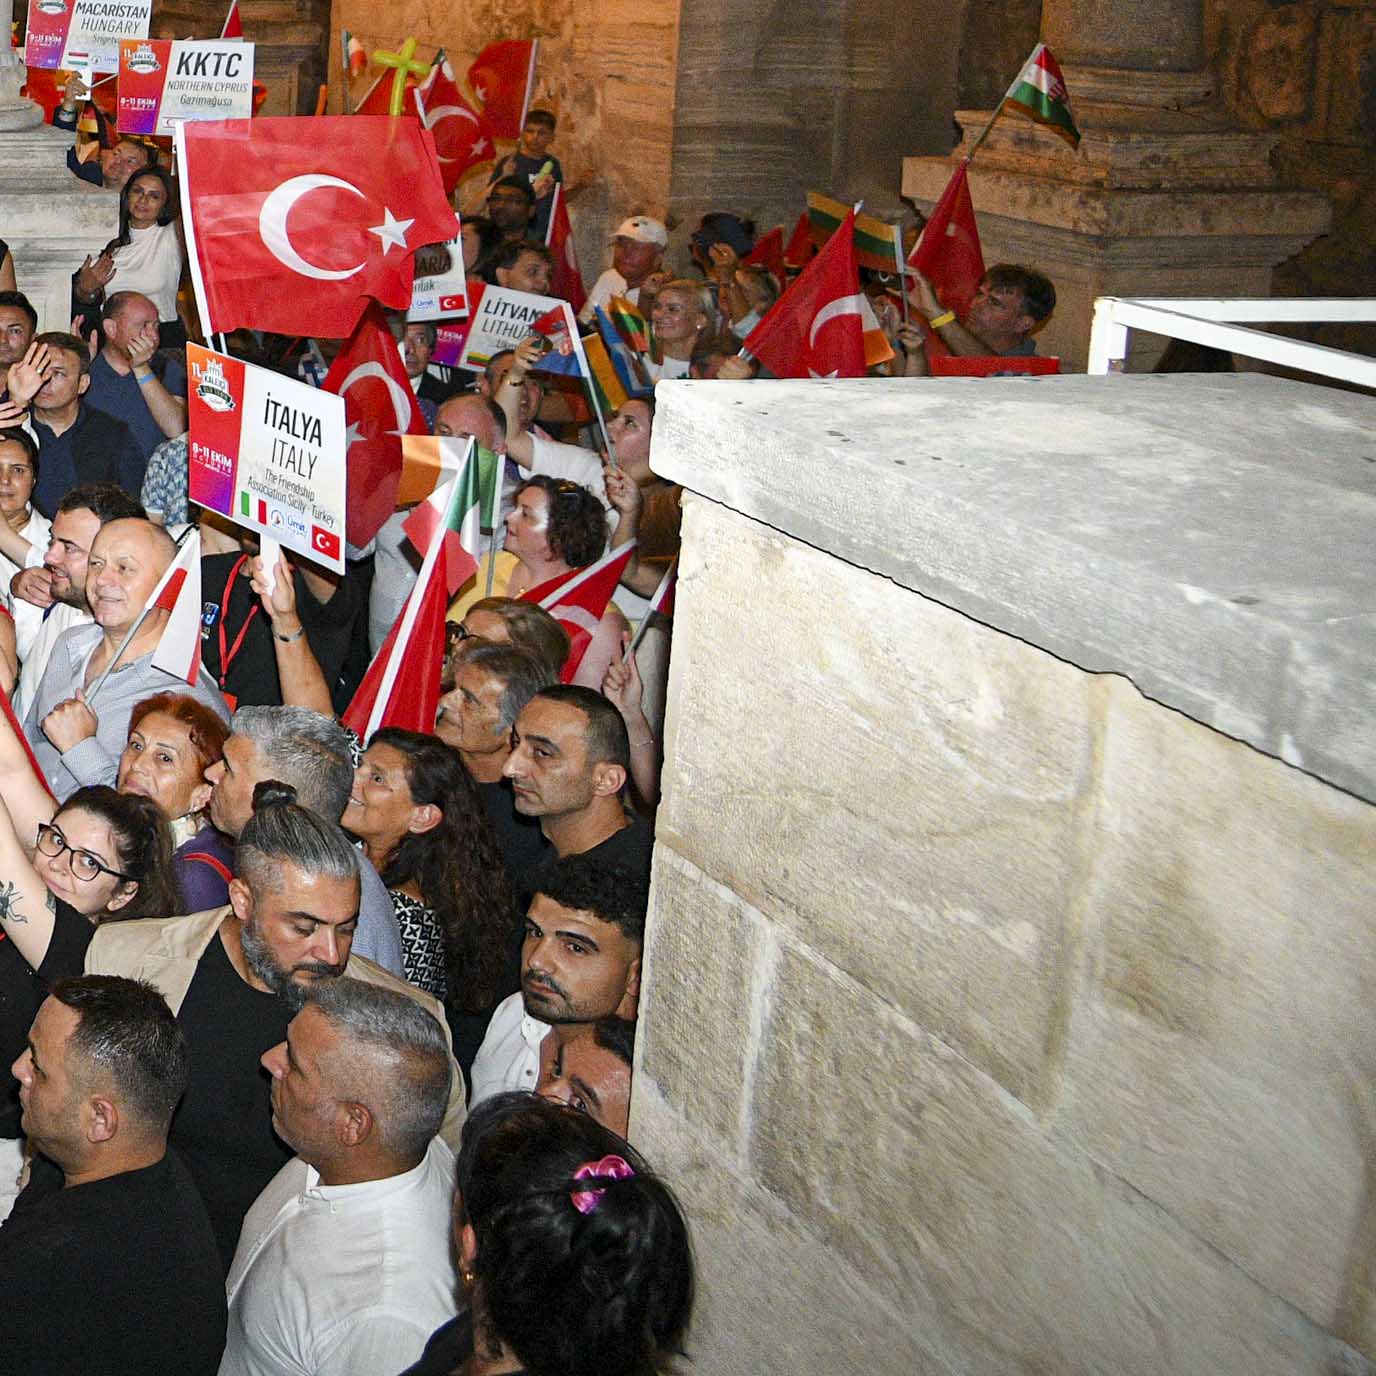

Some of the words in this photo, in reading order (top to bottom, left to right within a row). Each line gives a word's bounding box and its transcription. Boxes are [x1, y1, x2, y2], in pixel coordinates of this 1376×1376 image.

[75, 1, 149, 19] MACARİSTAN
[80, 17, 141, 34] HUNGARY
[176, 51, 242, 77] KKTC
[167, 80, 213, 92] NORTHERN
[214, 83, 248, 93] CYPRUS
[180, 94, 233, 108] Gazimağusa
[416, 255, 452, 274] ARIA
[484, 298, 540, 323] LİTVAN
[481, 317, 531, 339] LITHUA
[263, 392, 322, 447] İTALYA
[192, 442, 209, 458] 8-11
[210, 449, 232, 468] EKİM
[271, 437, 318, 480] ITALY
[265, 468, 277, 485] The
[278, 474, 315, 502] Friendship
[247, 476, 287, 505] Association
[287, 493, 306, 515] Sicily
[311, 504, 336, 528] Turkey
